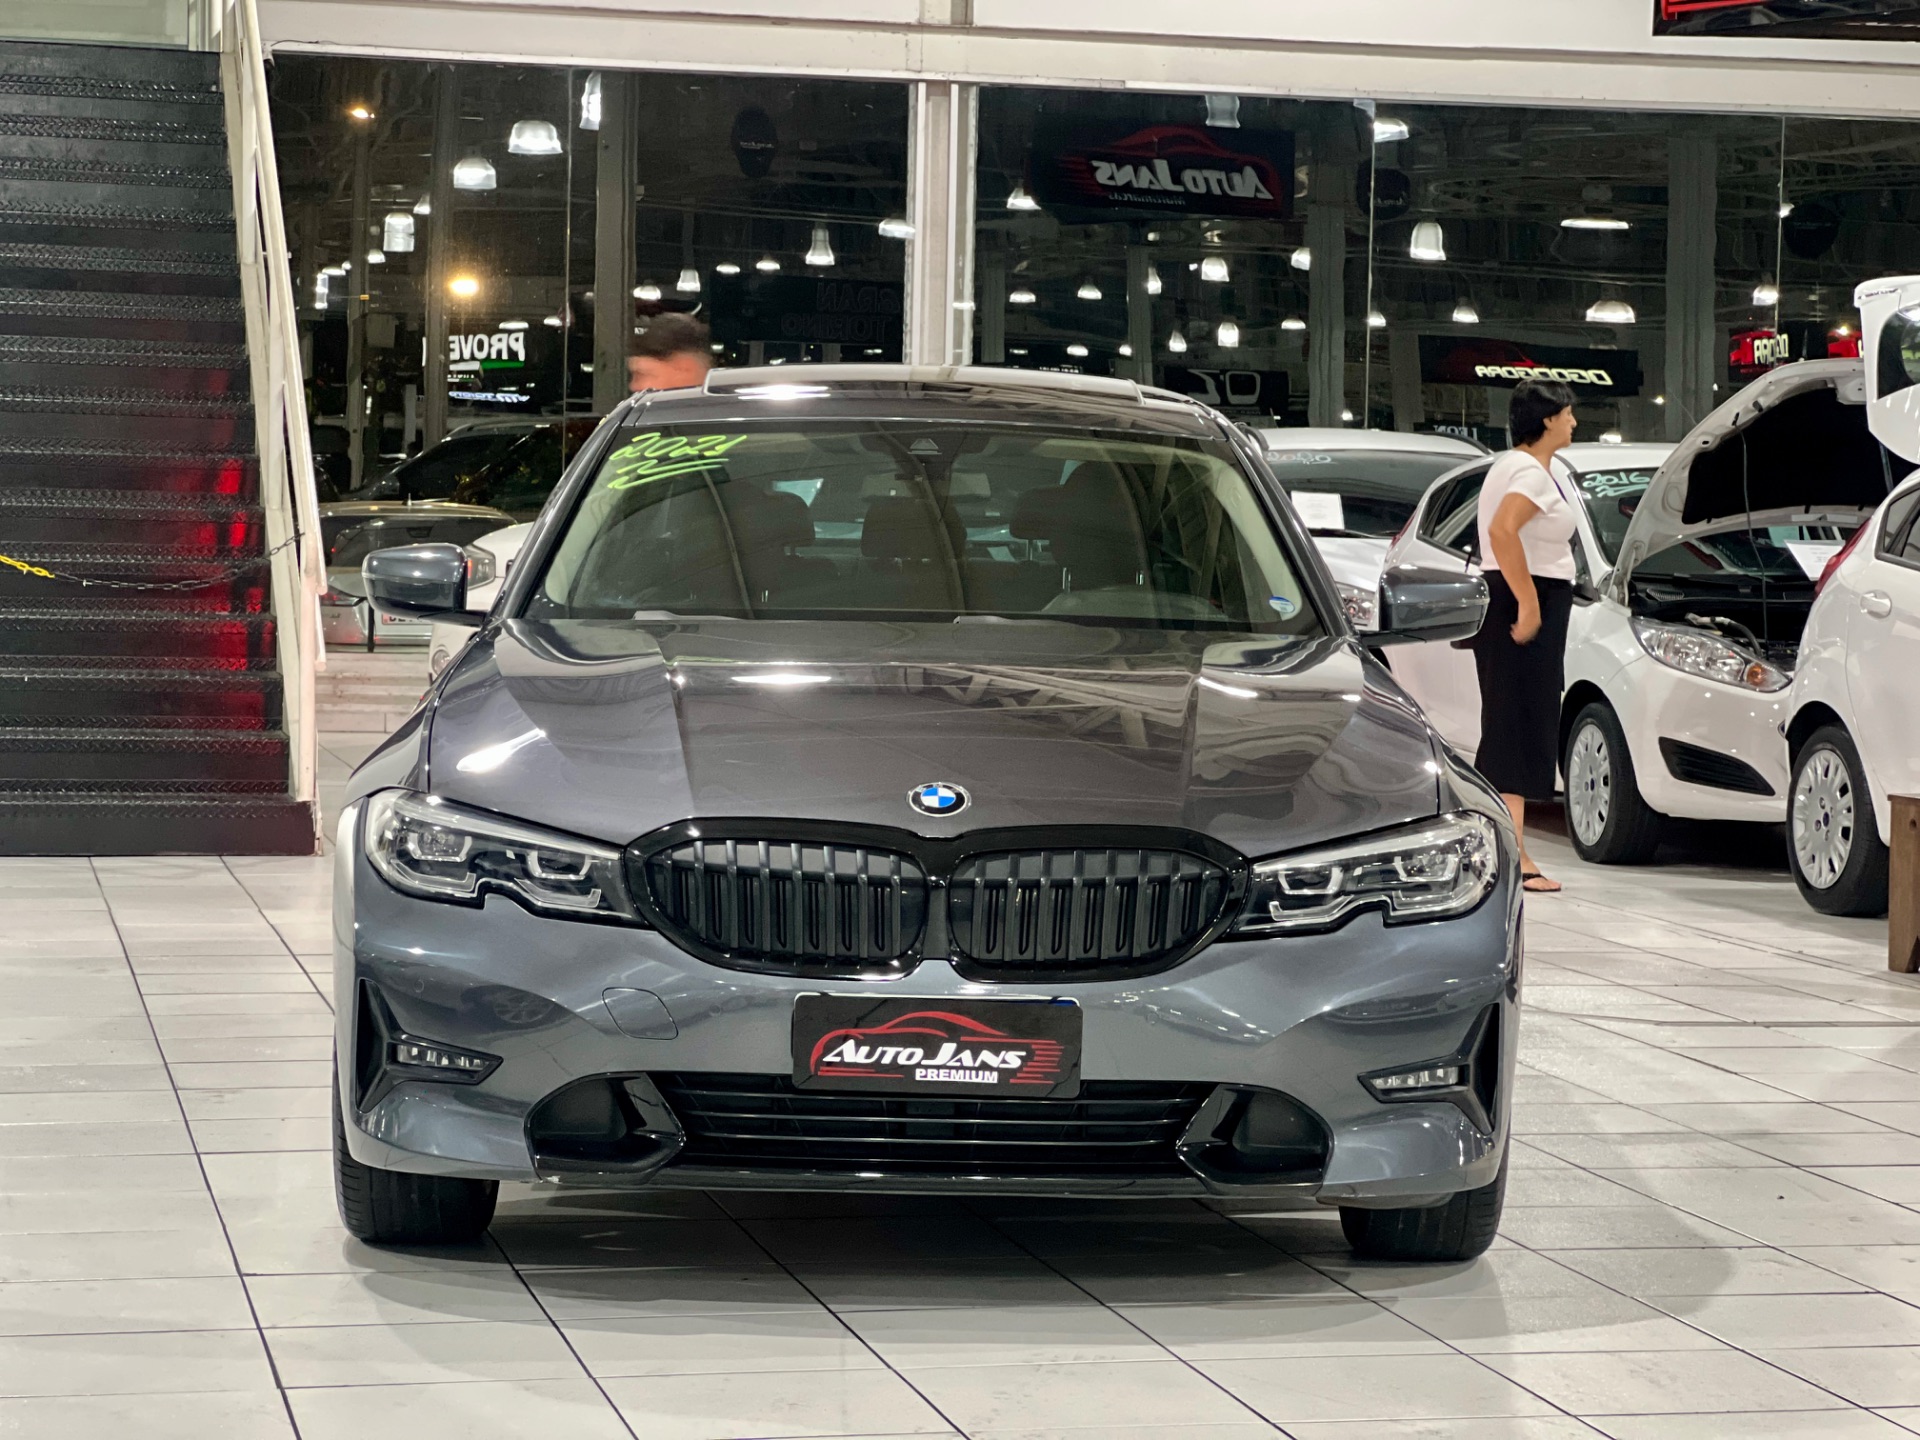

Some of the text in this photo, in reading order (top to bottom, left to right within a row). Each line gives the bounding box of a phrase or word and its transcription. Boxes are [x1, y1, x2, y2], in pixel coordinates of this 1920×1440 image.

[608, 431, 748, 461] 2021
[1582, 471, 1651, 488] 2016
[822, 1038, 1027, 1069] AUTO JANS
[915, 1067, 999, 1084] PREMIUM
